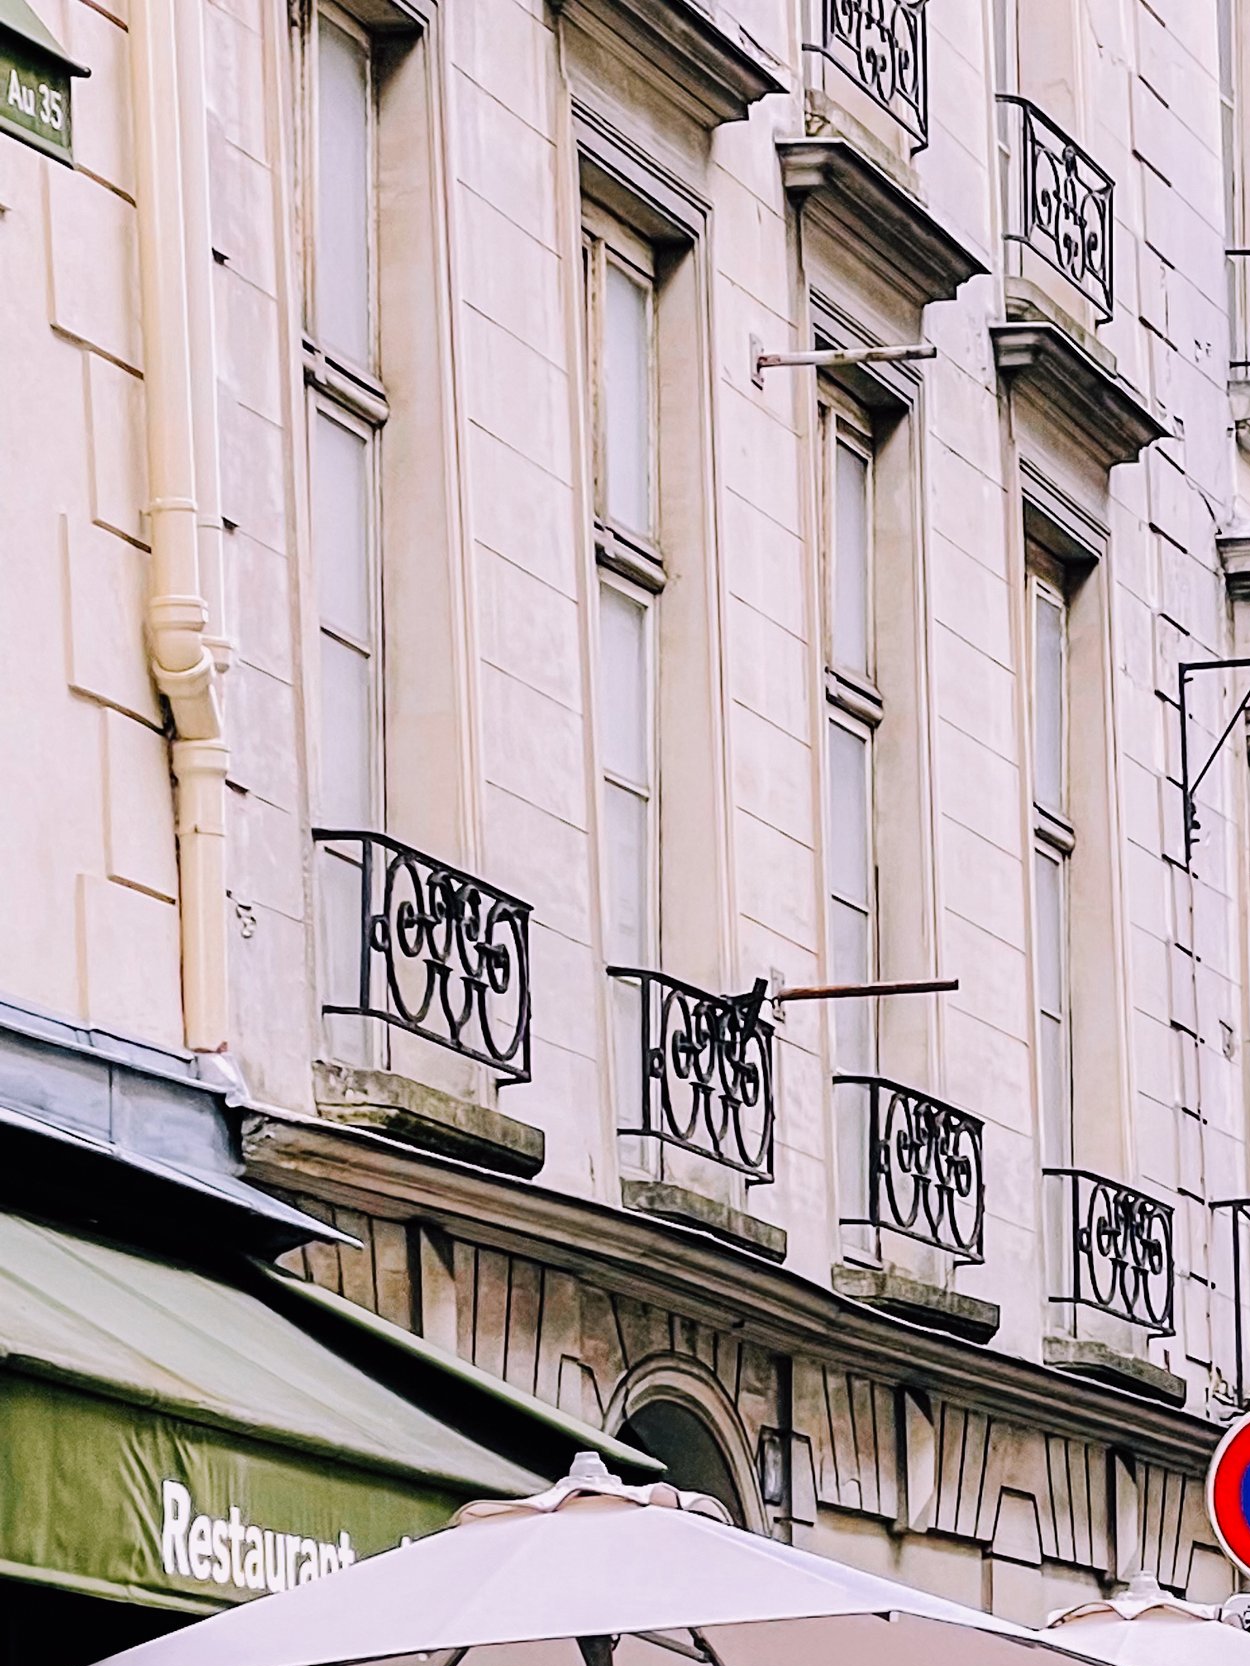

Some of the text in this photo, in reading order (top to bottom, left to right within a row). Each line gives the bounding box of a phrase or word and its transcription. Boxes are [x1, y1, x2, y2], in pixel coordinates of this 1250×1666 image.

[8, 69, 64, 130] Au 35
[162, 1479, 355, 1592] Restaurant
